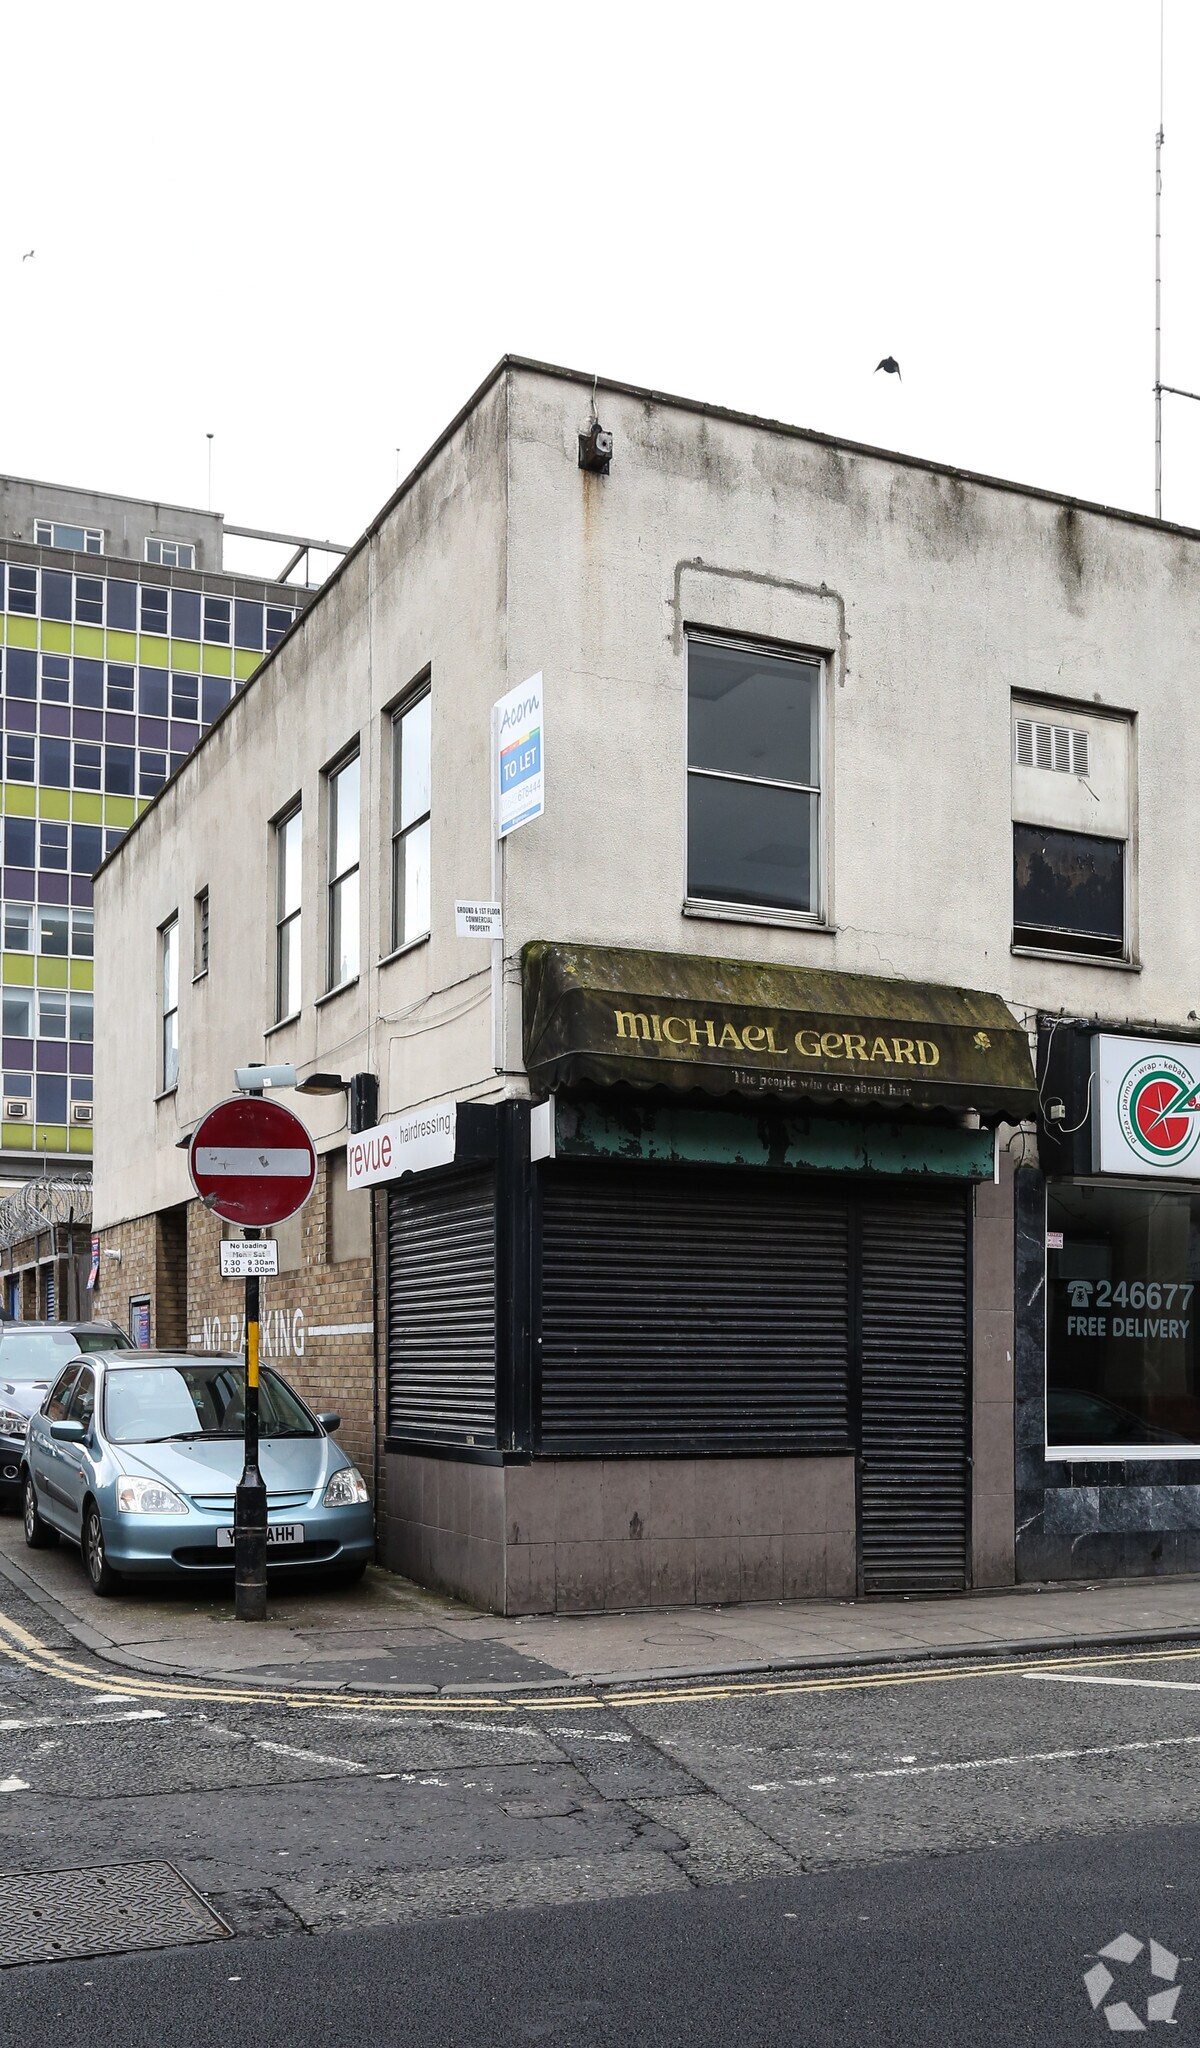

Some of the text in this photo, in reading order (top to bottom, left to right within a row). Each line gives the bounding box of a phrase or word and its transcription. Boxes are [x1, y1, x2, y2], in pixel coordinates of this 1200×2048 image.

[500, 695, 540, 734] Acorn
[504, 747, 536, 781] TO LET
[487, 907, 500, 915] FLOOR
[469, 924, 490, 932] PROPERTY
[1138, 1062, 1157, 1075] wrap
[1163, 1061, 1187, 1080] kebab
[731, 1070, 912, 1097] The people who care about hair
[1122, 1080, 1133, 1111] parmo
[349, 1113, 451, 1177] revue hairdressing
[1123, 1120, 1137, 1145] pizza
[242, 1242, 268, 1250] loading
[1095, 1280, 1195, 1310] 246677
[203, 1308, 305, 1357] NO PAKING
[1067, 1316, 1190, 1339] FREE DELIVERY
